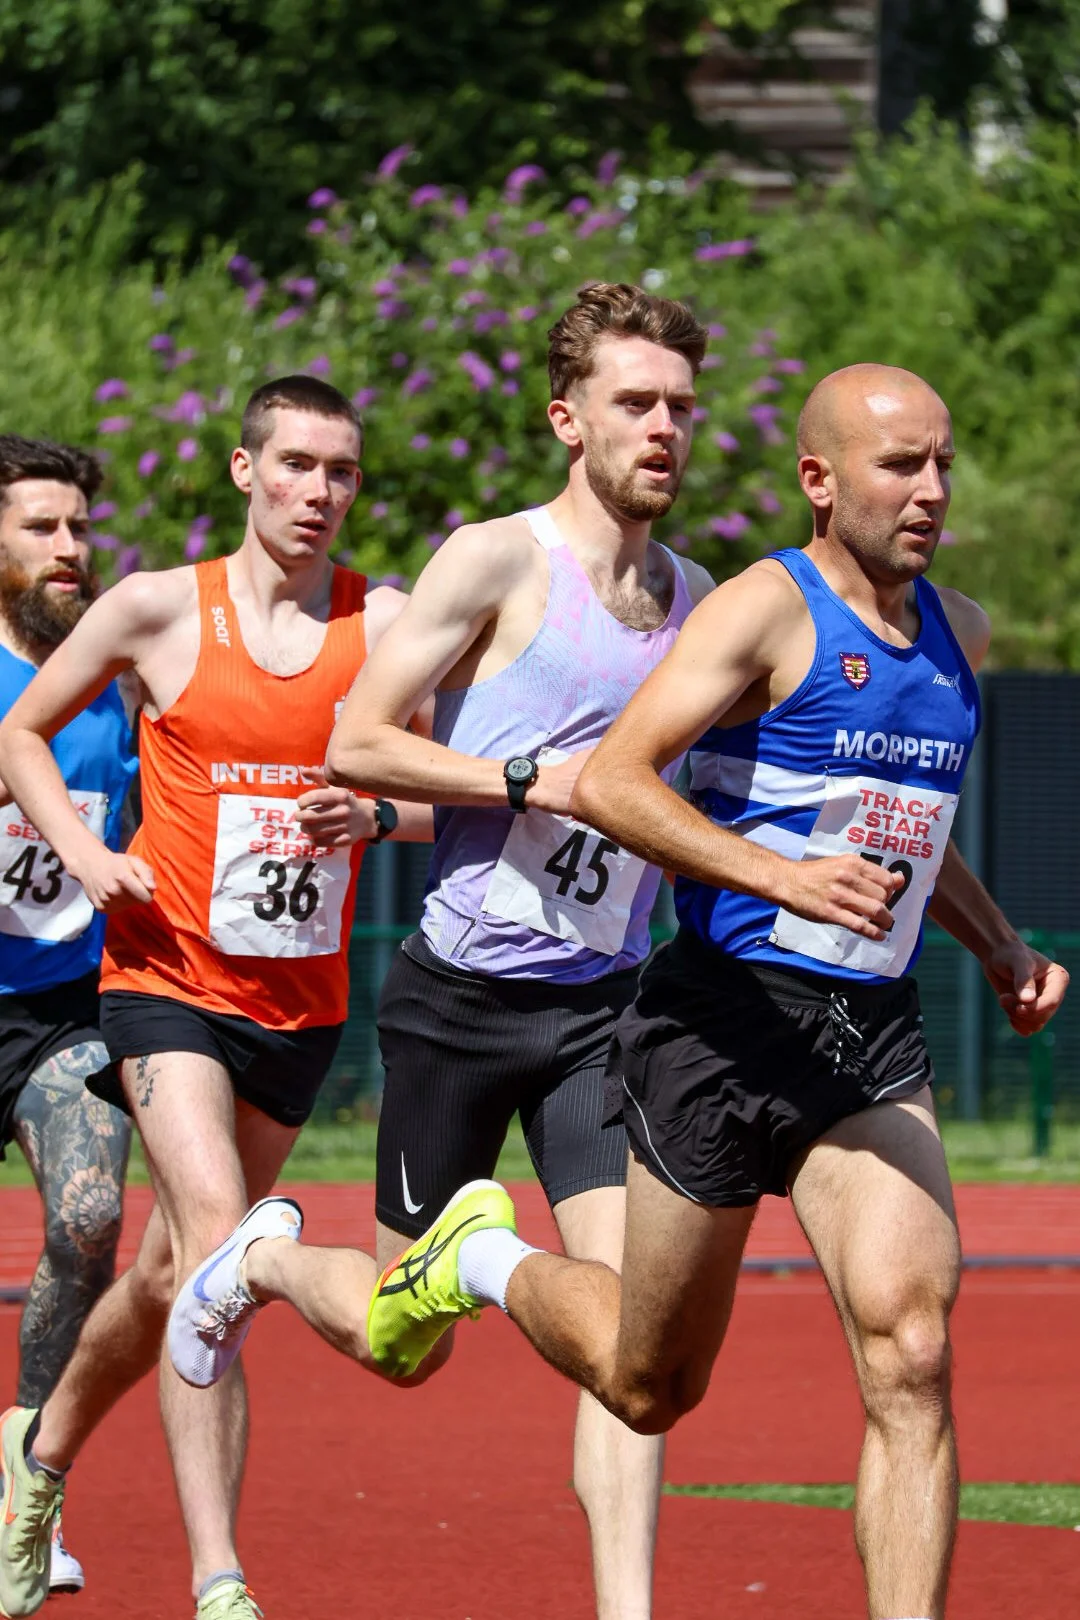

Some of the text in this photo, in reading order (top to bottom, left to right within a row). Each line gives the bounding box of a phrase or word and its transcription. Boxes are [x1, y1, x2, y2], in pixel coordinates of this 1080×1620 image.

[211, 606, 231, 648] soar
[833, 729, 964, 772] MORPETH
[860, 789, 943, 821] TRACK
[865, 811, 930, 838] STAR
[847, 826, 934, 859] SERIES
[2, 845, 65, 904] 43
[544, 829, 619, 906] 45
[253, 860, 319, 922] 36
[860, 852, 913, 932] 2
